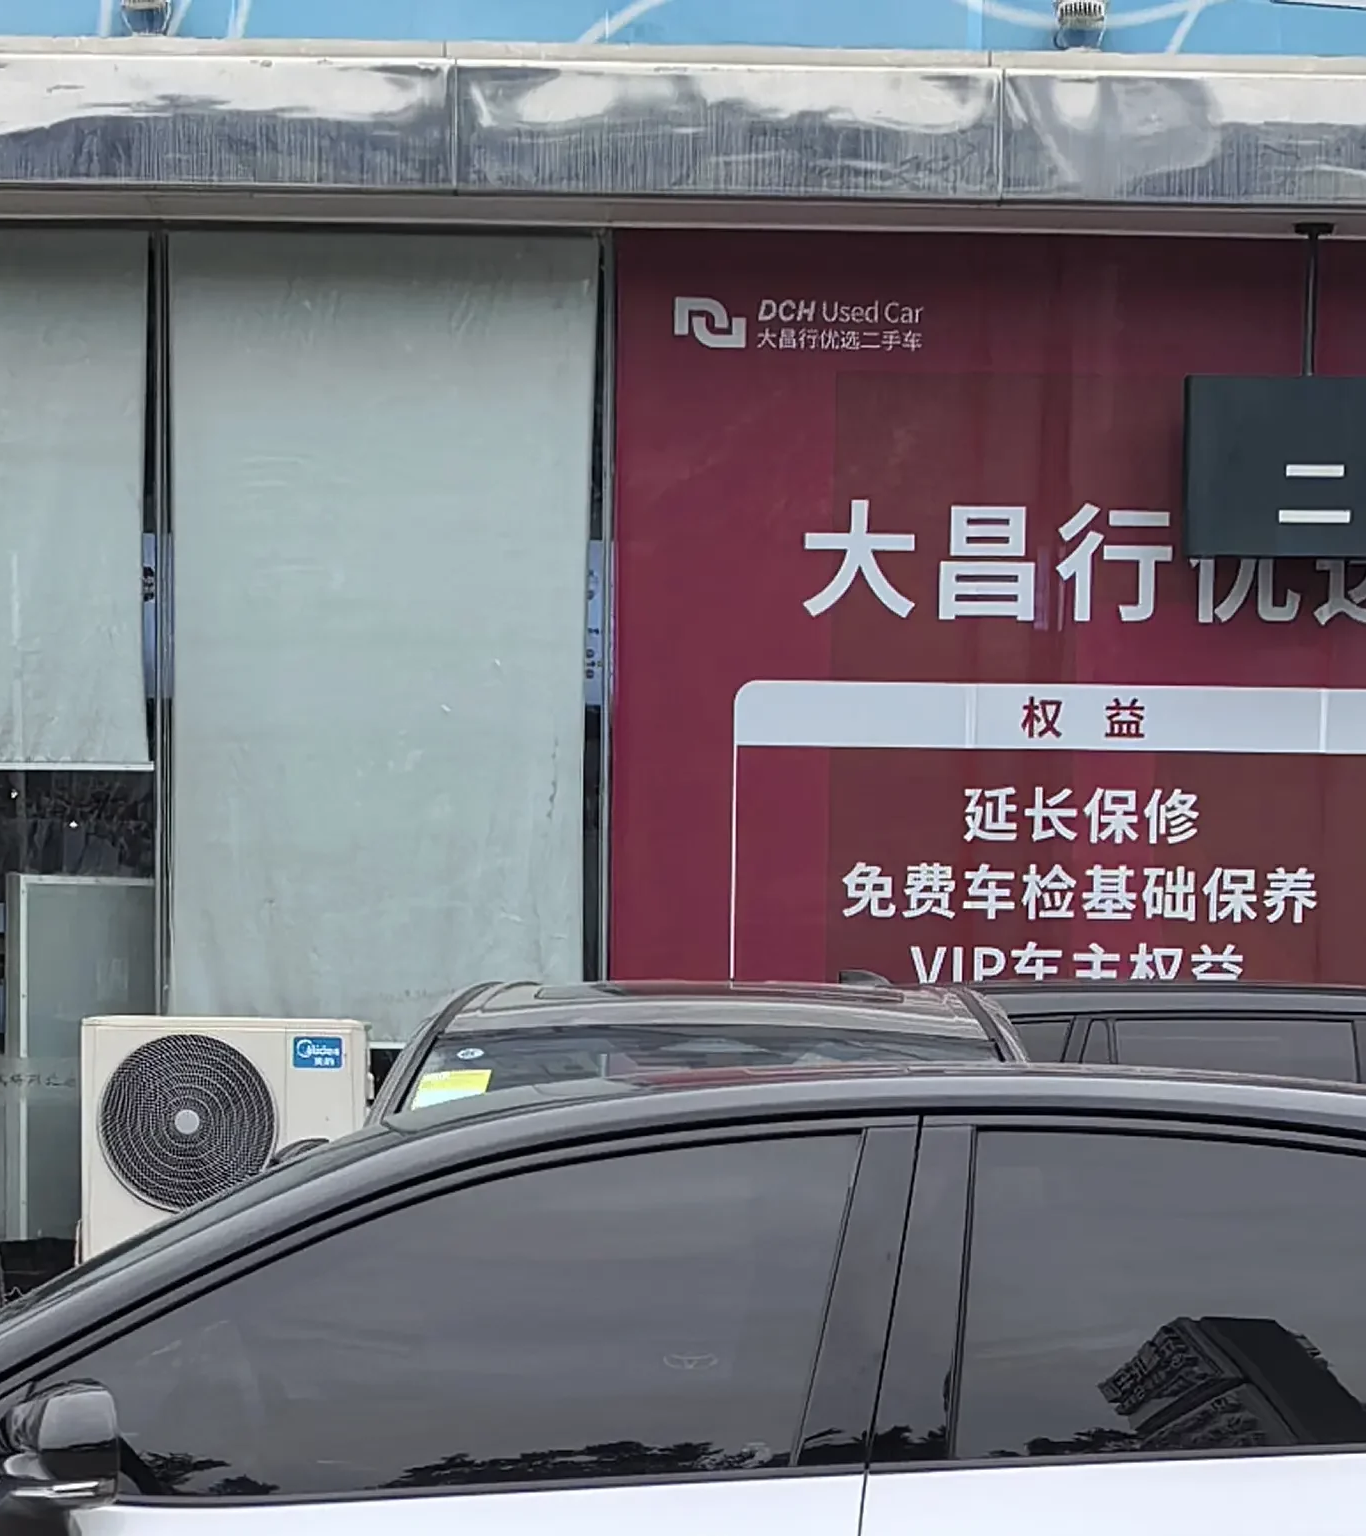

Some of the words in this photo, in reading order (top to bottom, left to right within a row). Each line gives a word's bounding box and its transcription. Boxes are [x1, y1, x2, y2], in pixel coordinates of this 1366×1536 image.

[757, 299, 816, 322] DCH
[822, 300, 879, 323] Used
[884, 302, 925, 325] Car
[757, 328, 923, 352] 大昌行优选二手车
[1020, 697, 1147, 741] 权益
[962, 786, 1201, 845] 延长保修
[840, 860, 1319, 924] 免费车检基础保养
[909, 941, 1244, 984] VIP车主权益
